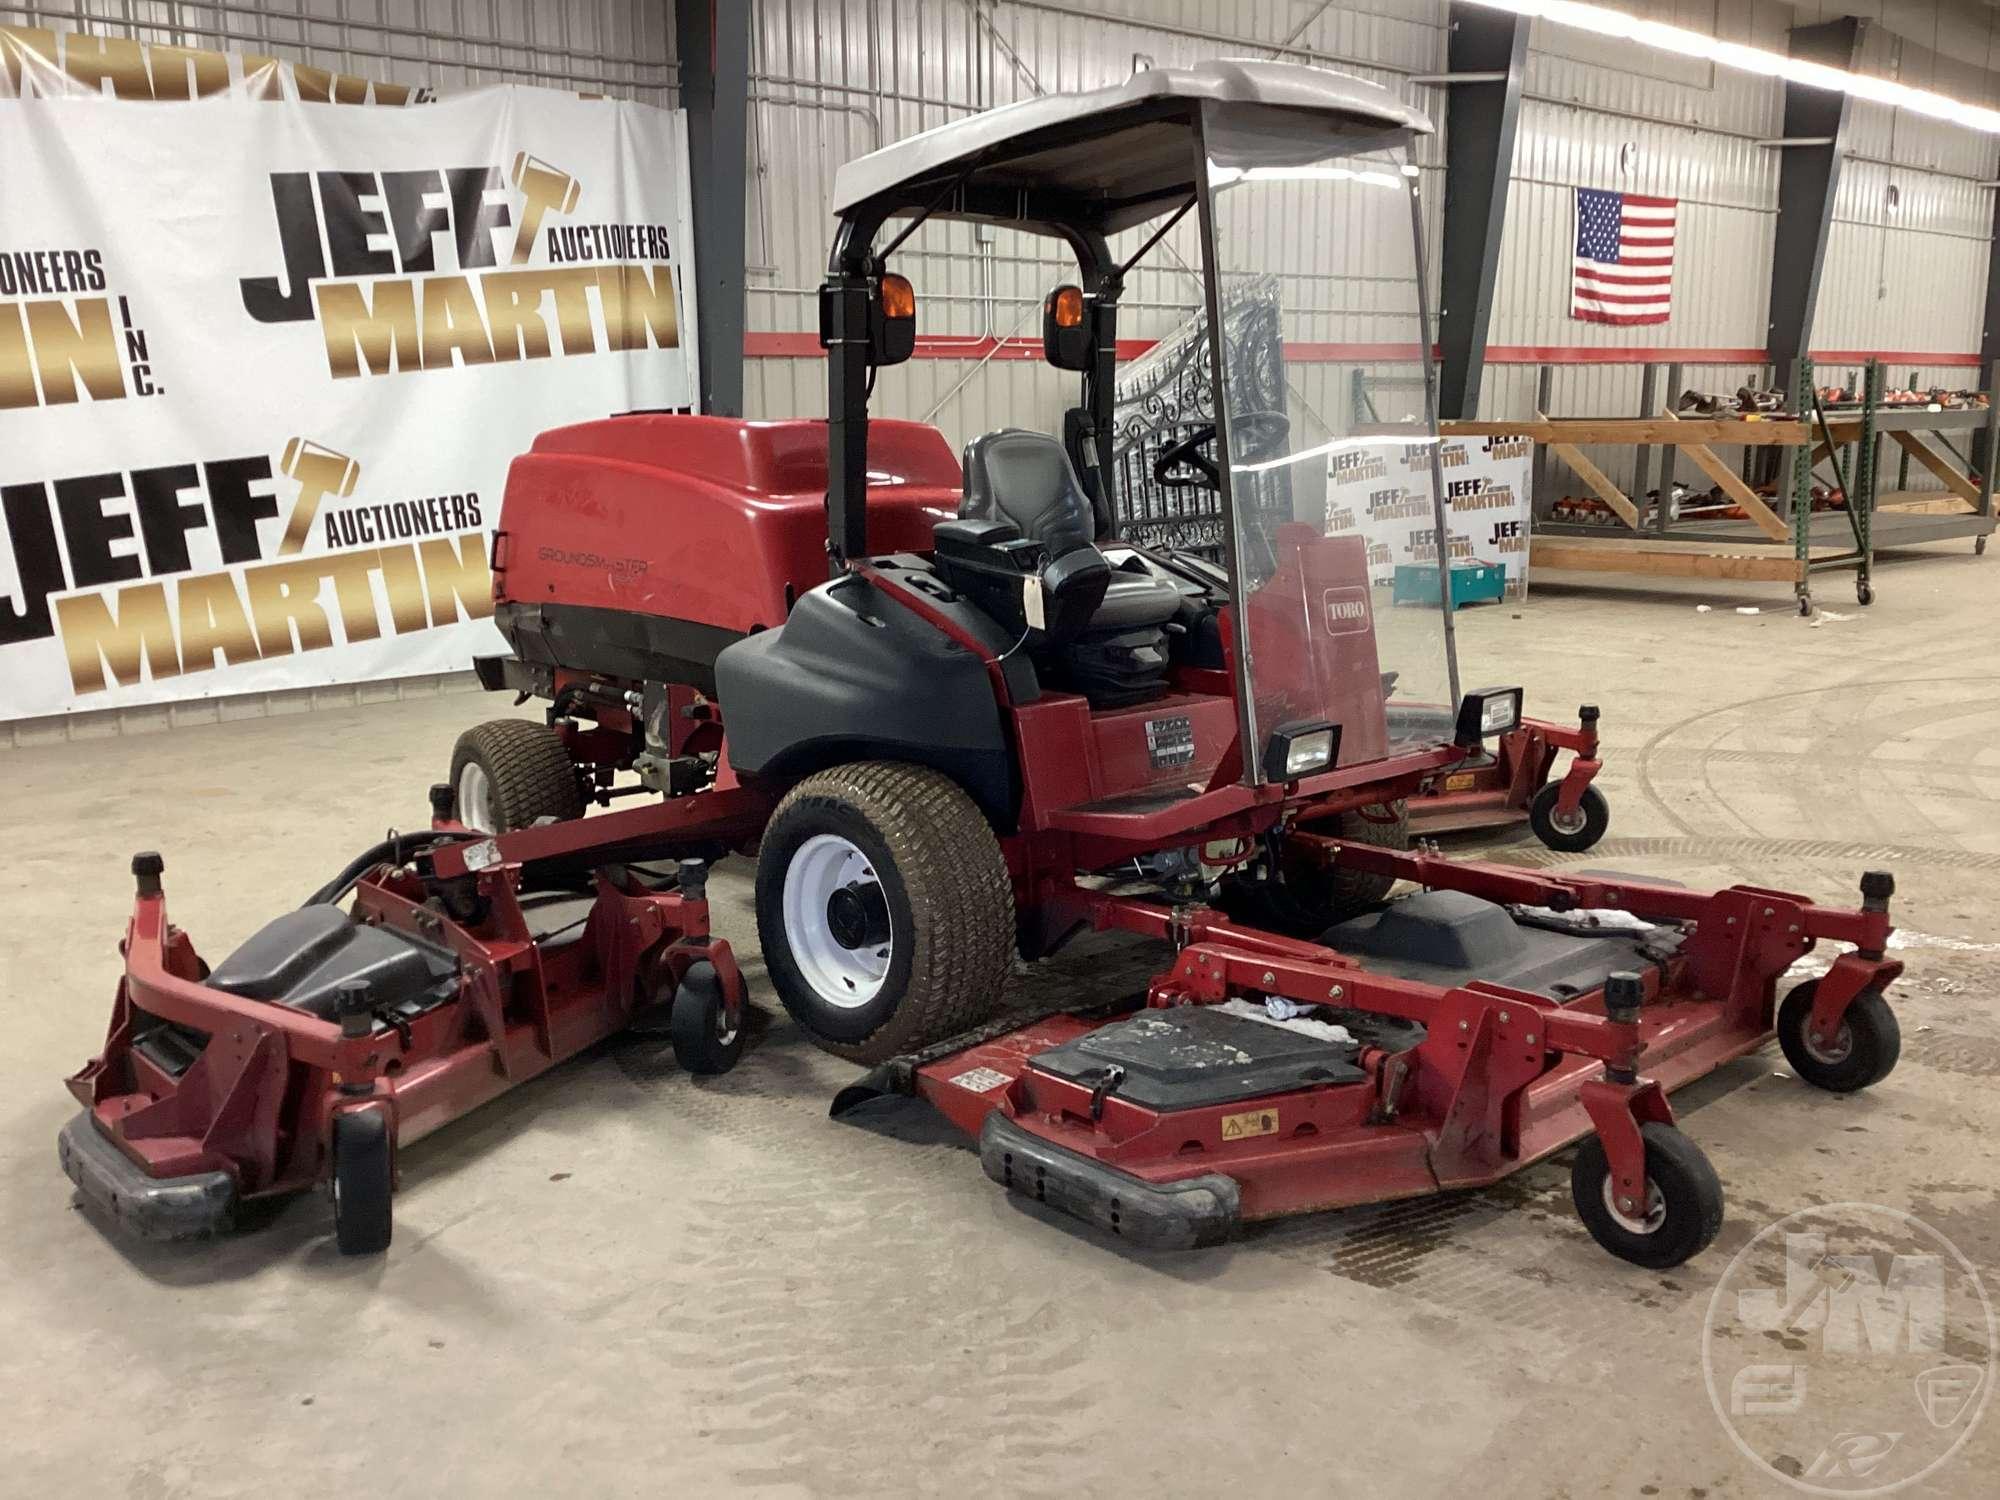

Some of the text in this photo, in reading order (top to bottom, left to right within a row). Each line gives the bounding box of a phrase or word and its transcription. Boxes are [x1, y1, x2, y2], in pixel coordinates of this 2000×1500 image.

[239, 166, 511, 323] JEFF
[547, 225, 670, 263] AUCTIONEERS
[315, 265, 679, 379] MARTIN
[1328, 451, 1360, 479] JEFF
[1336, 462, 1383, 486] MARTIN
[1366, 489, 1400, 514] JEFF
[1444, 478, 1482, 504] JEFF
[1452, 491, 1512, 512] MARTIN
[325, 492, 482, 549] AUCTIONEERS
[0, 455, 279, 645] JEFF
[538, 546, 648, 576] GROUNDSMSTER
[55, 532, 496, 696] MARTIN
[1328, 601, 1365, 620] TORO
